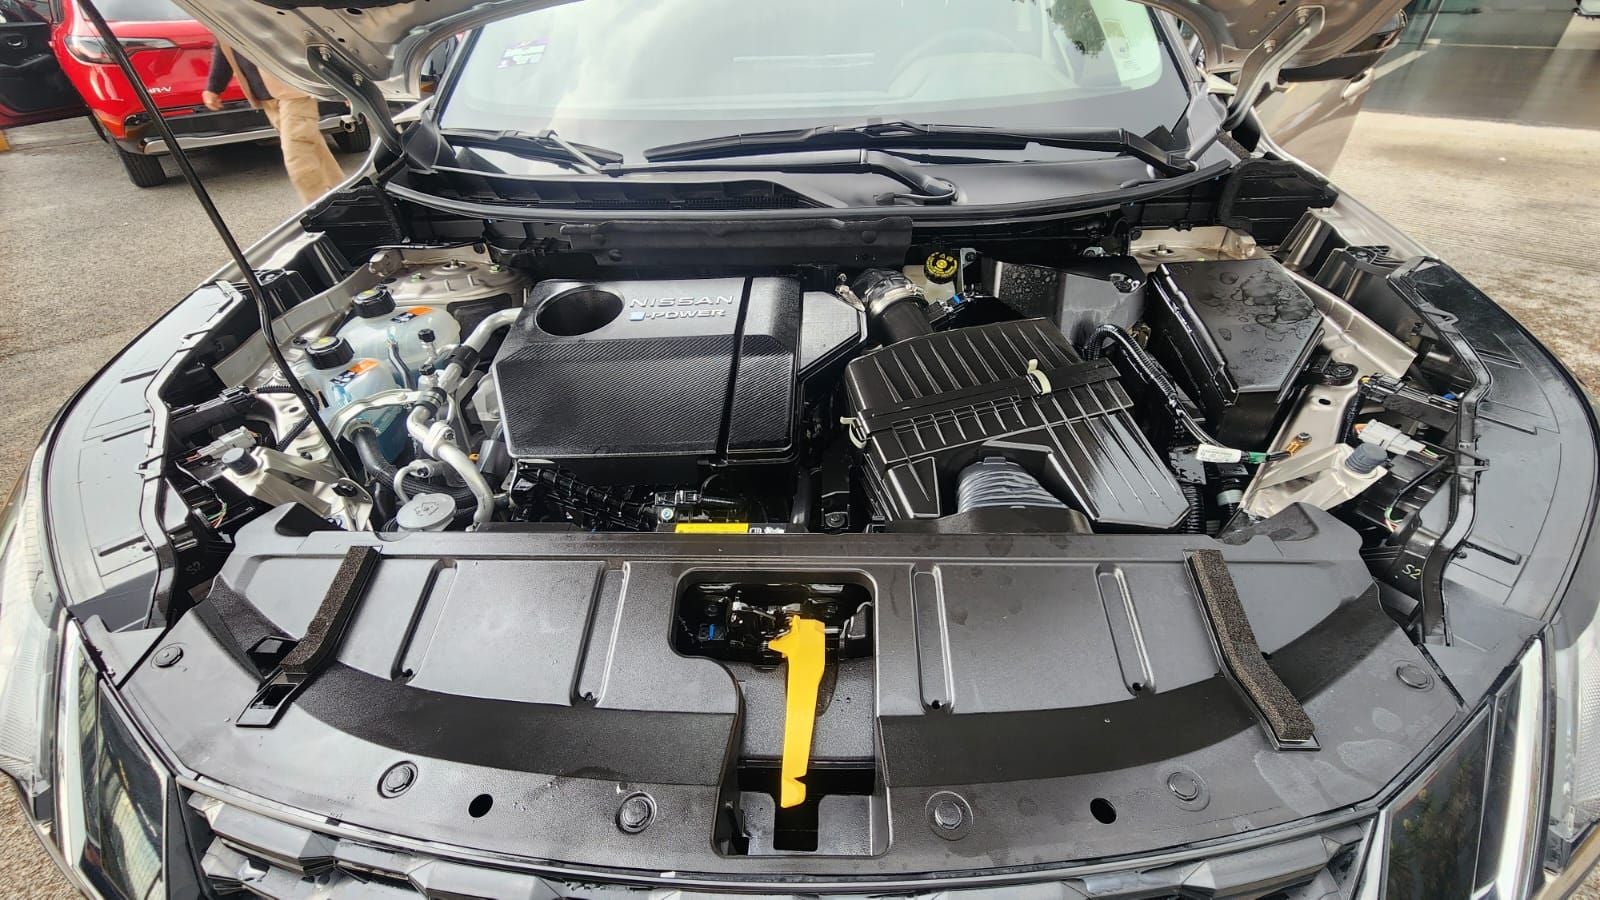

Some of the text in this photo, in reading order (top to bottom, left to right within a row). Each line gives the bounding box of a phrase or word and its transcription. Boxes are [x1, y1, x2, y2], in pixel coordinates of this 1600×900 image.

[629, 295, 735, 308] NISSAN
[629, 308, 726, 322] -POWER
[1401, 563, 1422, 580] S2
